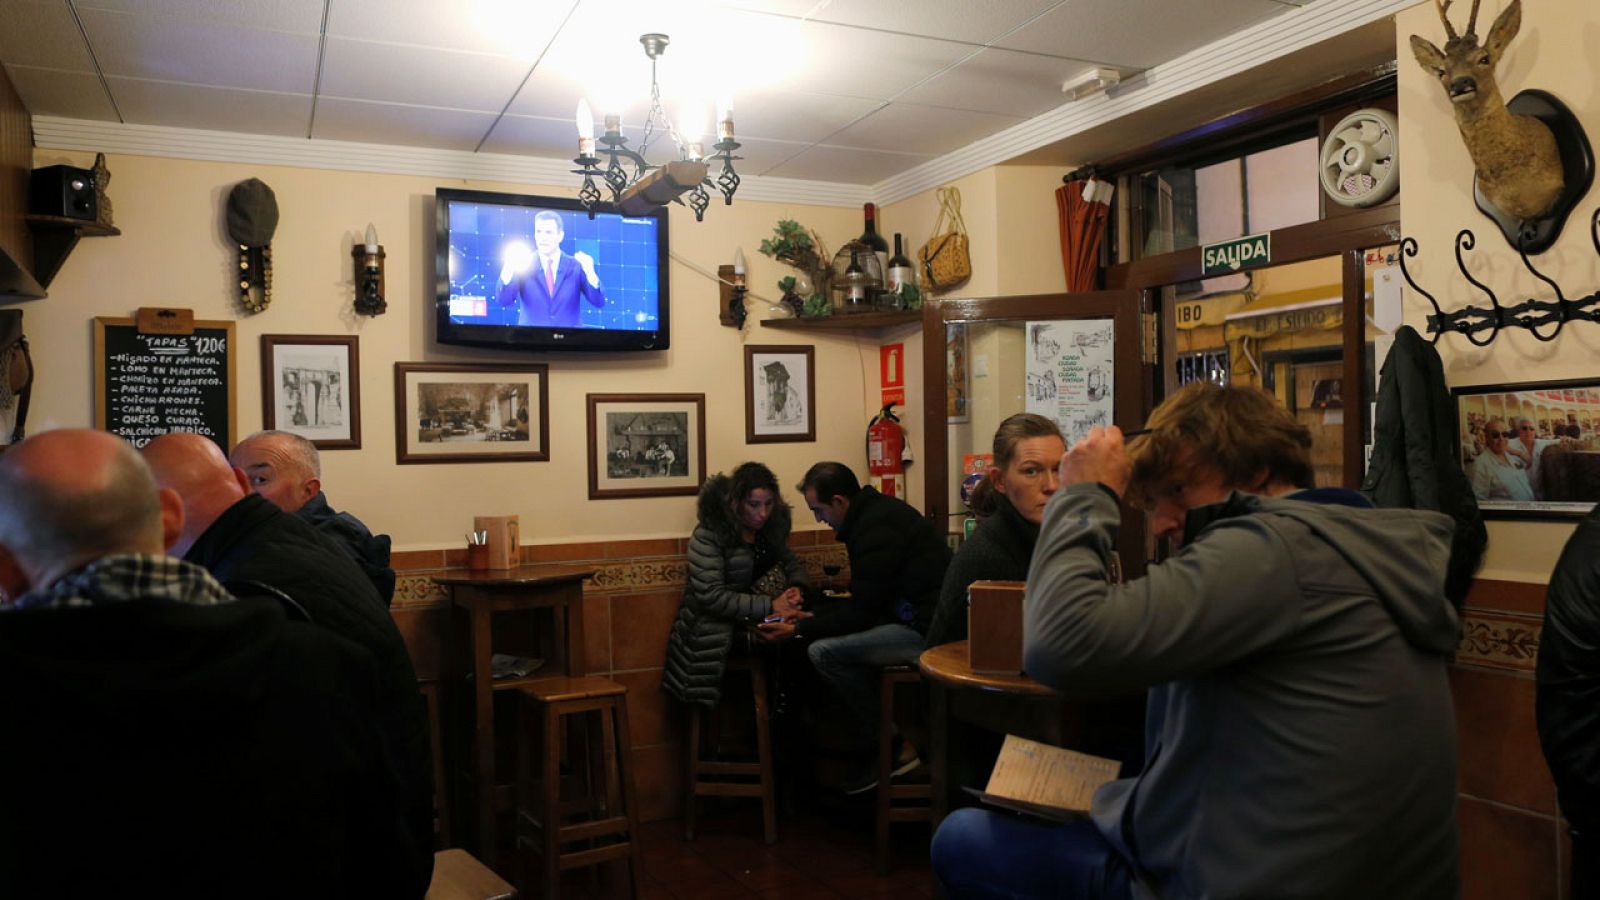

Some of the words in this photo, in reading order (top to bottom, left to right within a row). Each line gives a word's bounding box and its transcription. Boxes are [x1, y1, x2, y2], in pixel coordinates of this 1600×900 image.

[1205, 239, 1267, 268] SALIDA
[120, 365, 149, 373] LOMO
[153, 366, 166, 374] EN
[121, 414, 160, 425] QUESO
